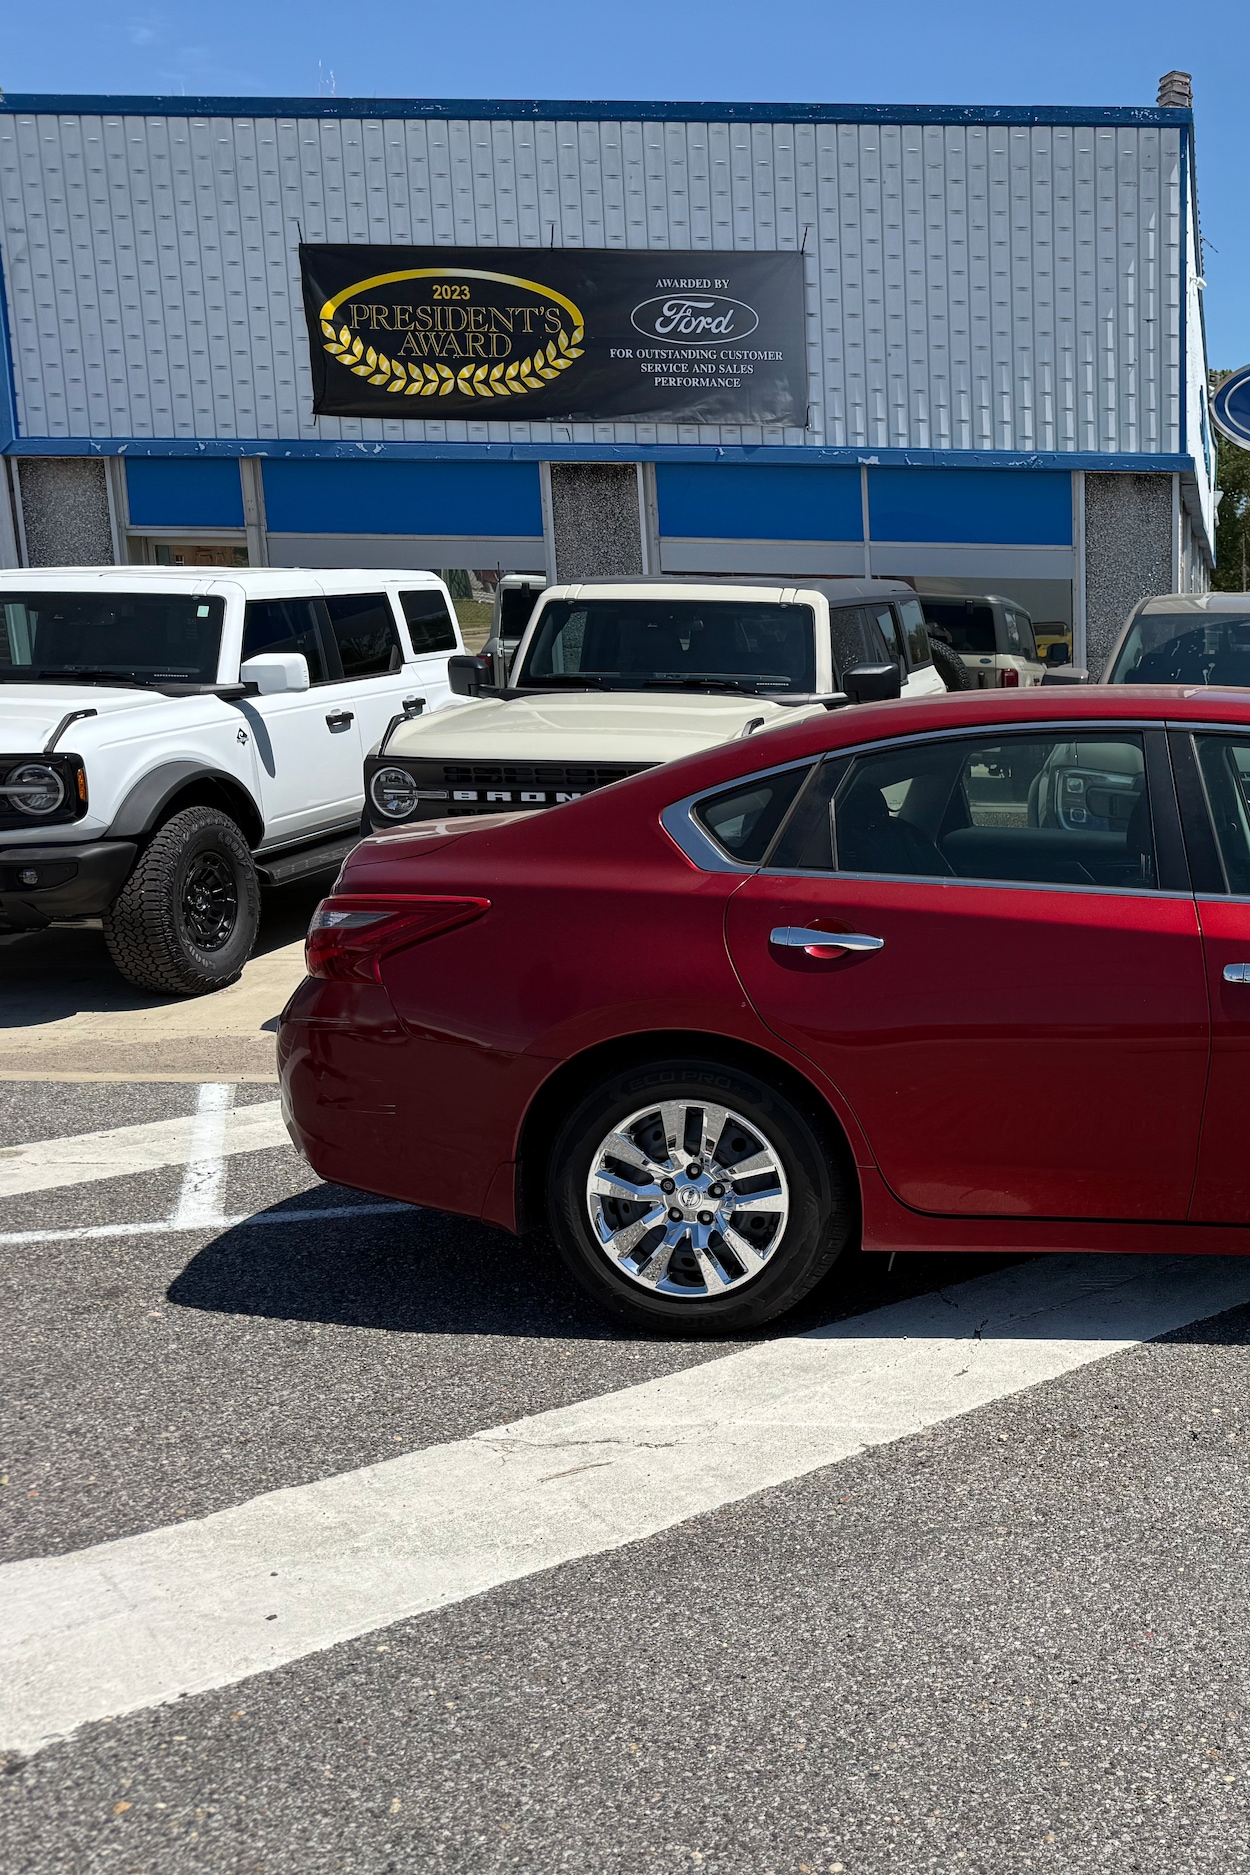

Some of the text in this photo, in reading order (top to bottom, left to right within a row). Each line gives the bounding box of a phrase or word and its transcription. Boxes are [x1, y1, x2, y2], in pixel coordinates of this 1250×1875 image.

[656, 278, 730, 289] AWARDED BY
[432, 285, 470, 300] 2023
[350, 304, 562, 334] PRESIDENT'S
[655, 300, 735, 334] Ford
[397, 332, 512, 358] AWARD
[610, 348, 783, 361] FOR OUTSTANDING CUSTOMER
[641, 363, 754, 374] SERVICE AND SALES
[654, 377, 741, 388] PERFORMANCE
[453, 790, 582, 802] BRON
[628, 1072, 675, 1089] ECO
[681, 1071, 731, 1089] PRO
